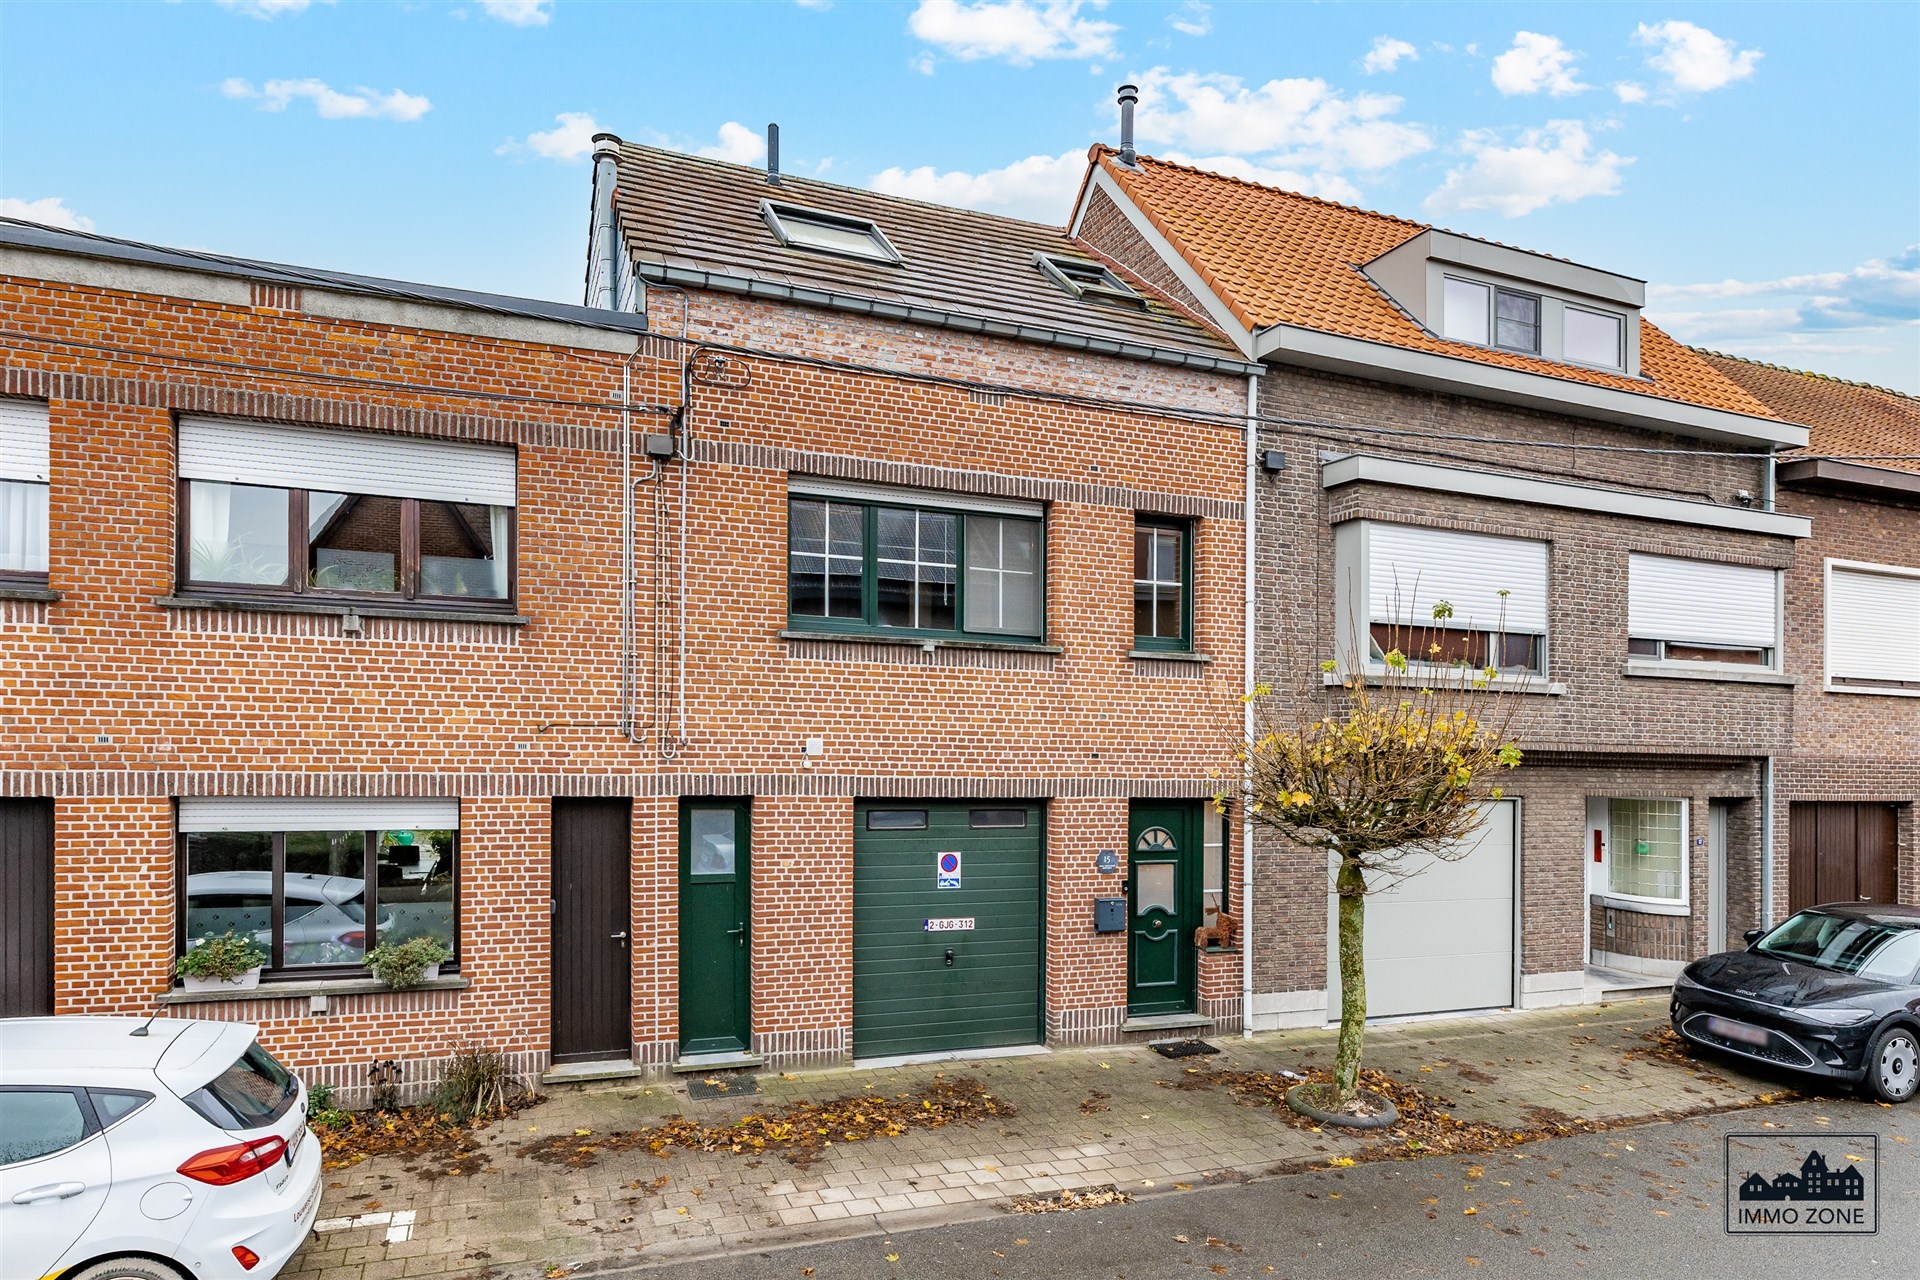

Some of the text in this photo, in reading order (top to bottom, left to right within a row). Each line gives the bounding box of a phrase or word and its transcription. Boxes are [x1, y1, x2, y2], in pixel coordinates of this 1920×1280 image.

[1104, 856, 1111, 864] 15
[929, 919, 974, 930] 2-GJG-312
[1735, 988, 1757, 997] smart
